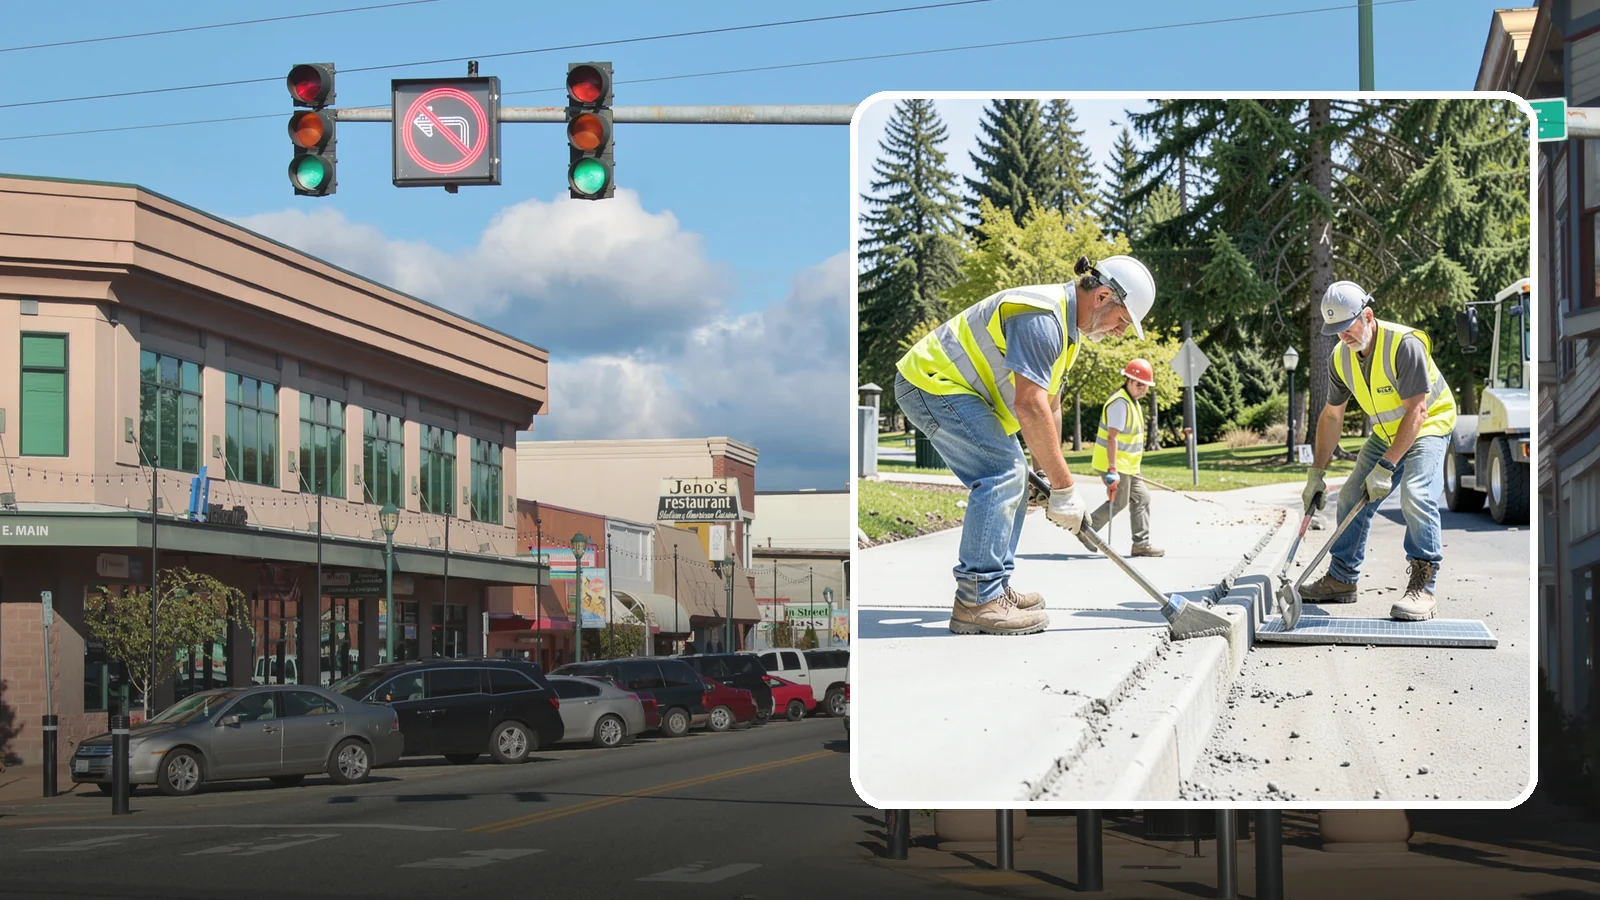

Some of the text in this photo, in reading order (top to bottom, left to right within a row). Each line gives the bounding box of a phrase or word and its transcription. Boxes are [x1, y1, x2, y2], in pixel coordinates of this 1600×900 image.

[670, 480, 727, 494] Jeno's
[665, 496, 731, 508] restaurant
[659, 509, 681, 519] Italian
[685, 509, 715, 519] American
[715, 509, 738, 519] Cuisine
[2, 525, 49, 536] E. MAIN
[797, 607, 829, 617] Street
